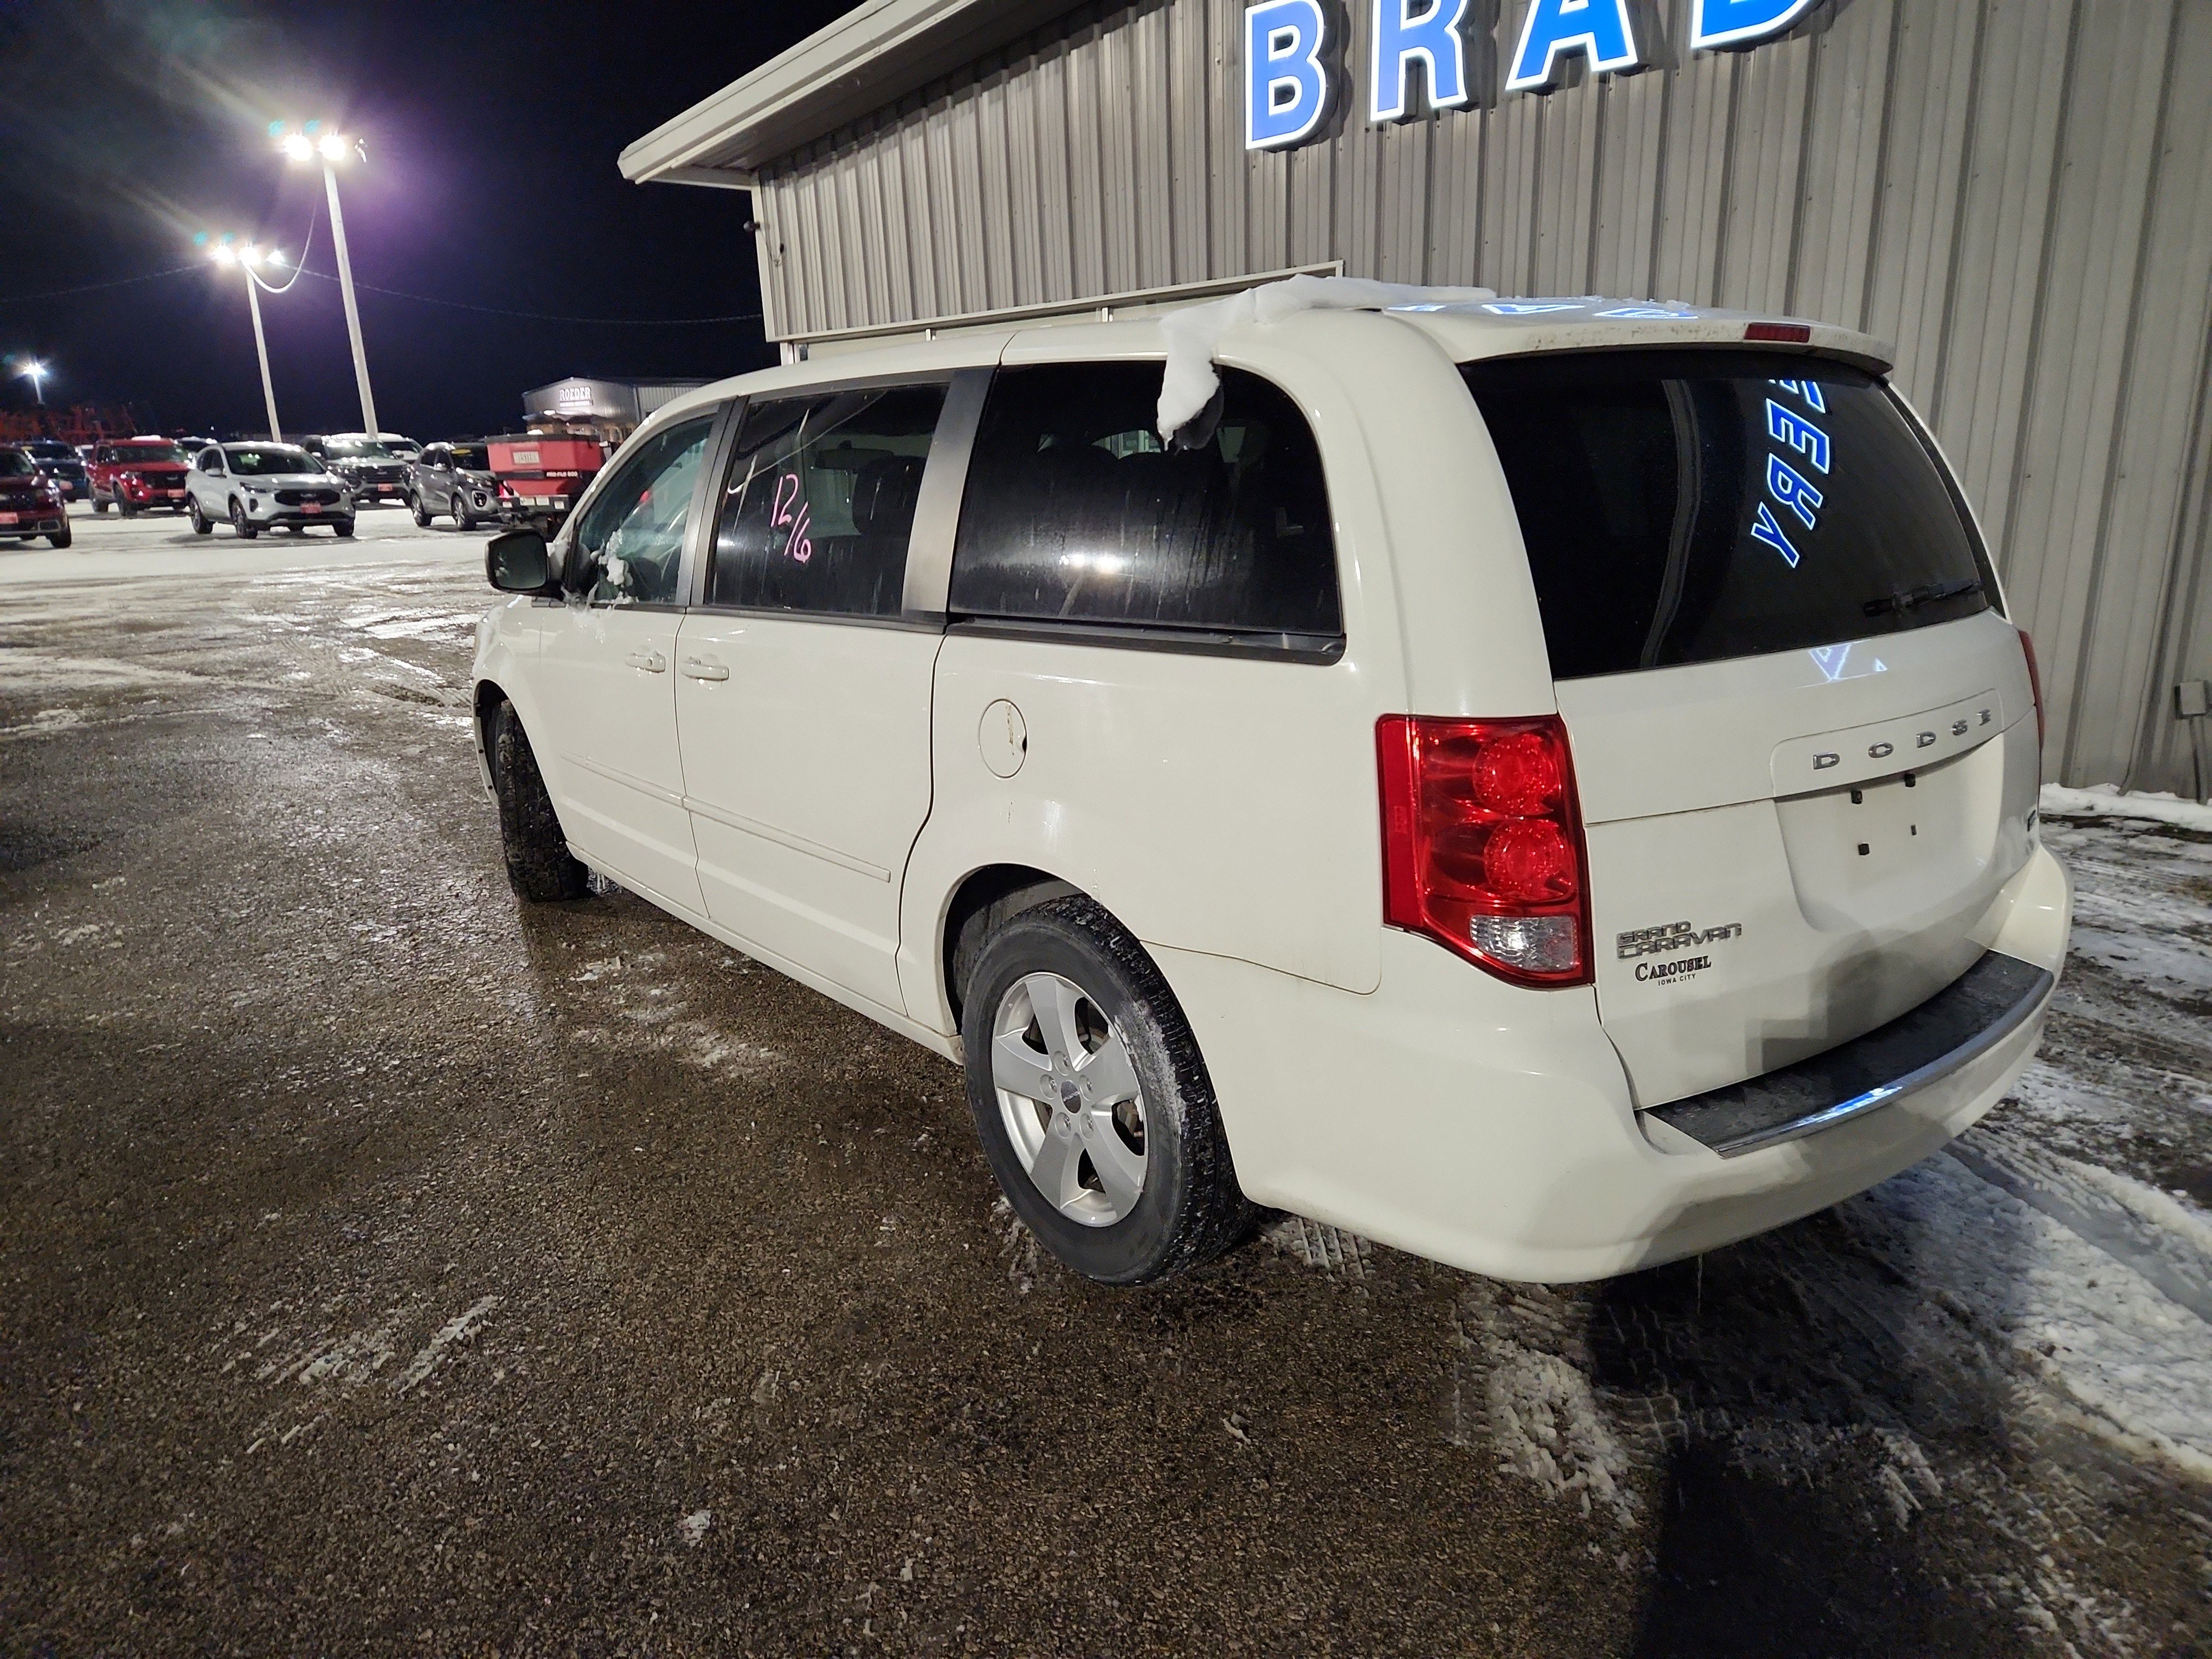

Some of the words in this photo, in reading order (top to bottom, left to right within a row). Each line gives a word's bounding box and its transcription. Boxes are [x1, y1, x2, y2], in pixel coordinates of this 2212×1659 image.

[560, 387, 591, 401] ROEDER
[1812, 709, 1991, 770] DODGE
[1617, 921, 1691, 945] GRAND
[1617, 923, 1742, 960] CARAVAN
[1658, 978, 1677, 986] IOWA
[1680, 973, 1696, 982] CITY
